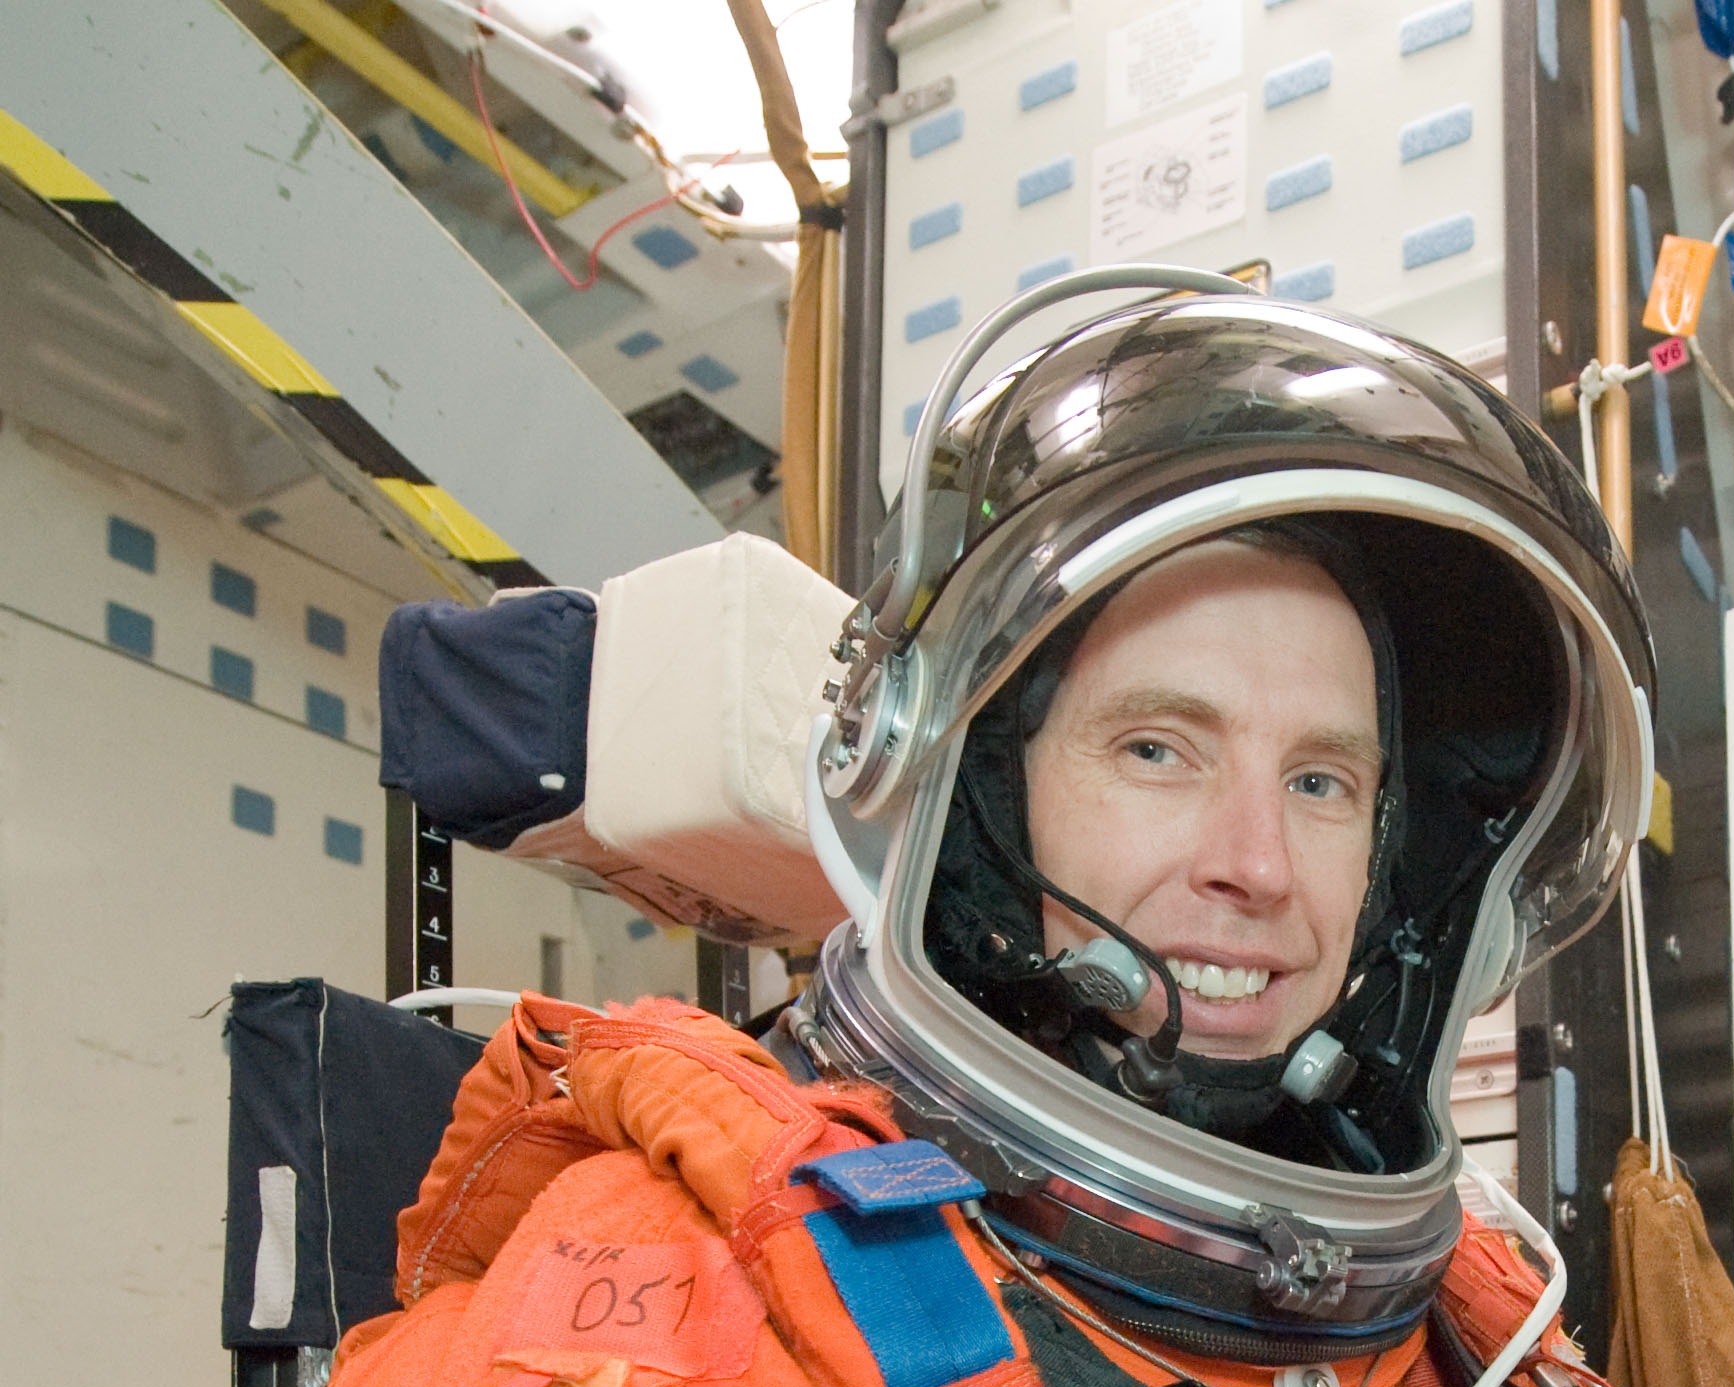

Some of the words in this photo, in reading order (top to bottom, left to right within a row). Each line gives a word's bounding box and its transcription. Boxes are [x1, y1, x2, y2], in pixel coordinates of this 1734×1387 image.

[429, 867, 440, 884] 3
[429, 916, 440, 934] 4
[429, 965, 440, 982] 5
